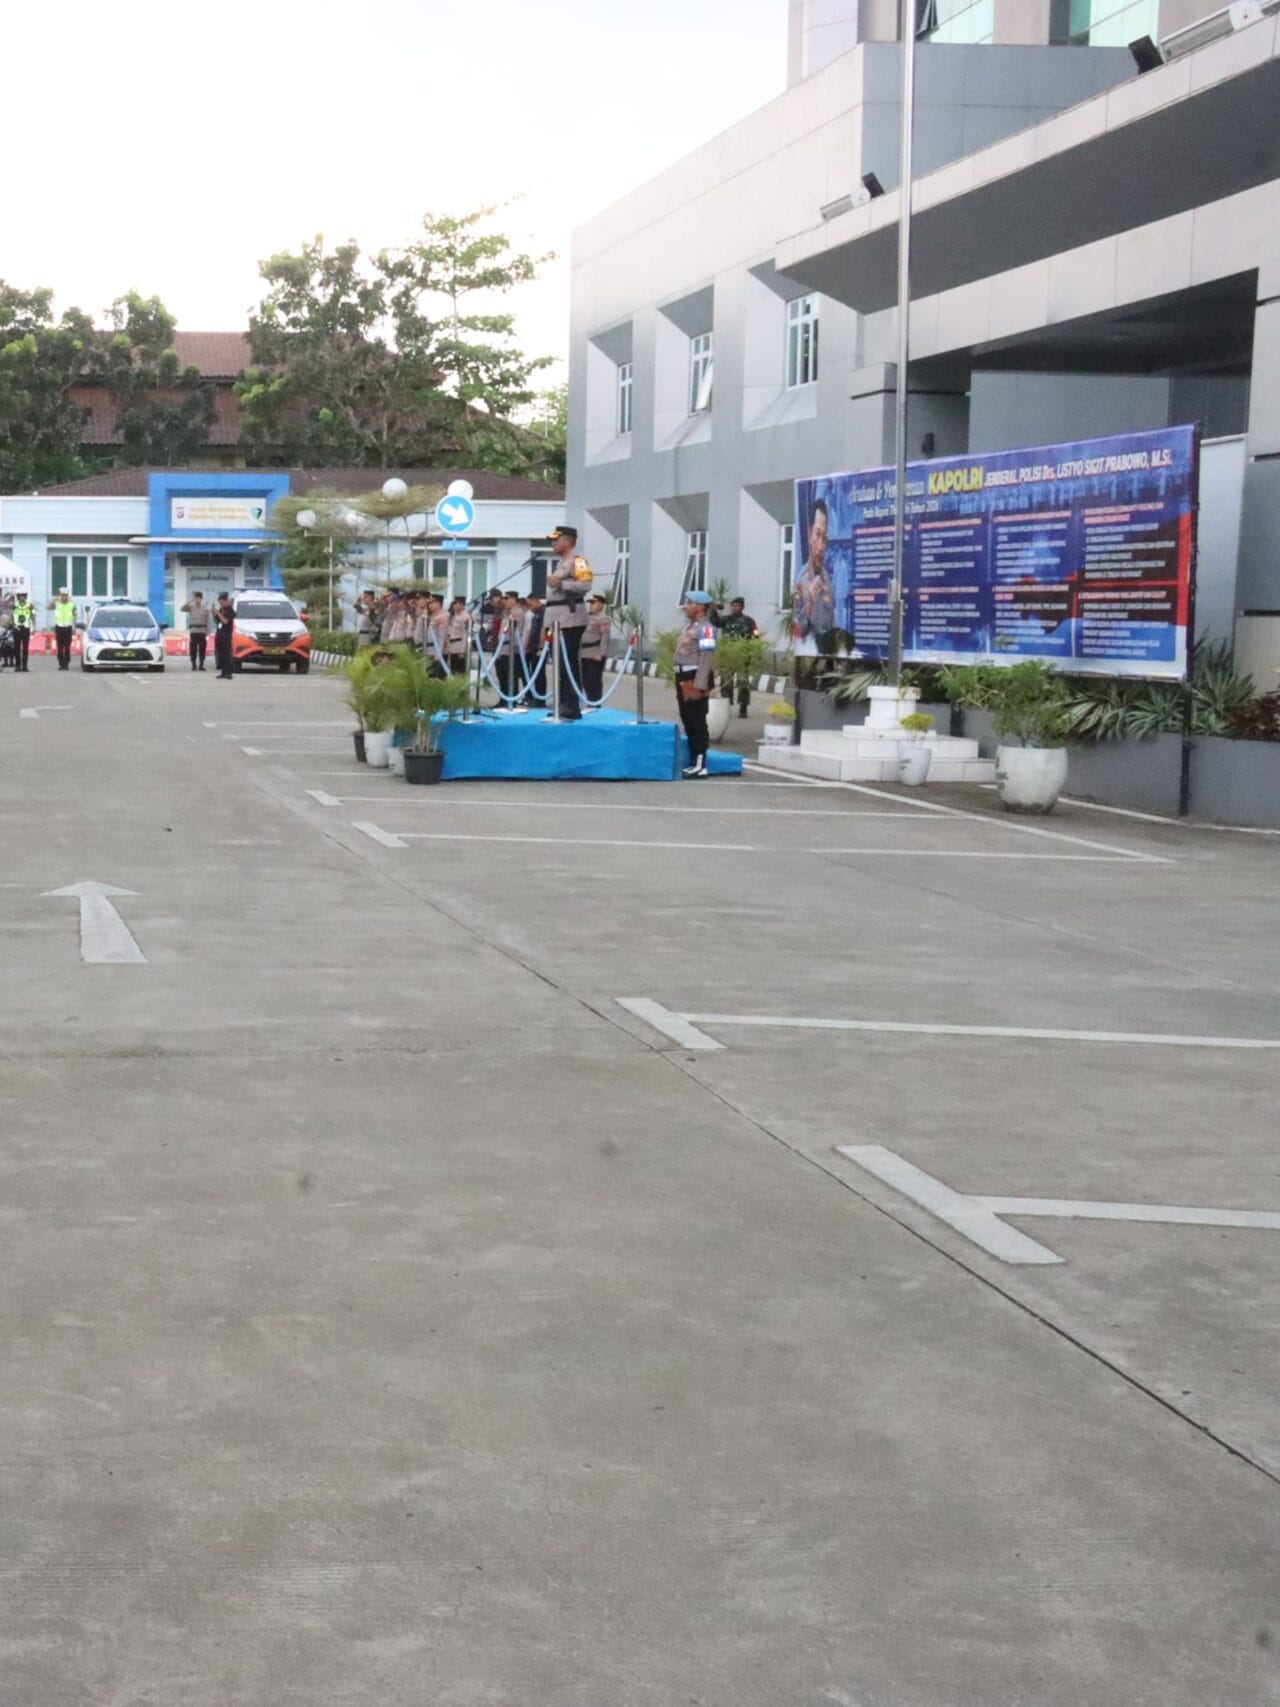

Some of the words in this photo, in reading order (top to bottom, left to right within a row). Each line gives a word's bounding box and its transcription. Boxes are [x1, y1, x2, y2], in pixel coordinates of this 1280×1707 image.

[928, 466, 984, 495] KAPOLRI
[1056, 460, 1083, 478] LISTYO
[1084, 457, 1104, 474] SIGIT
